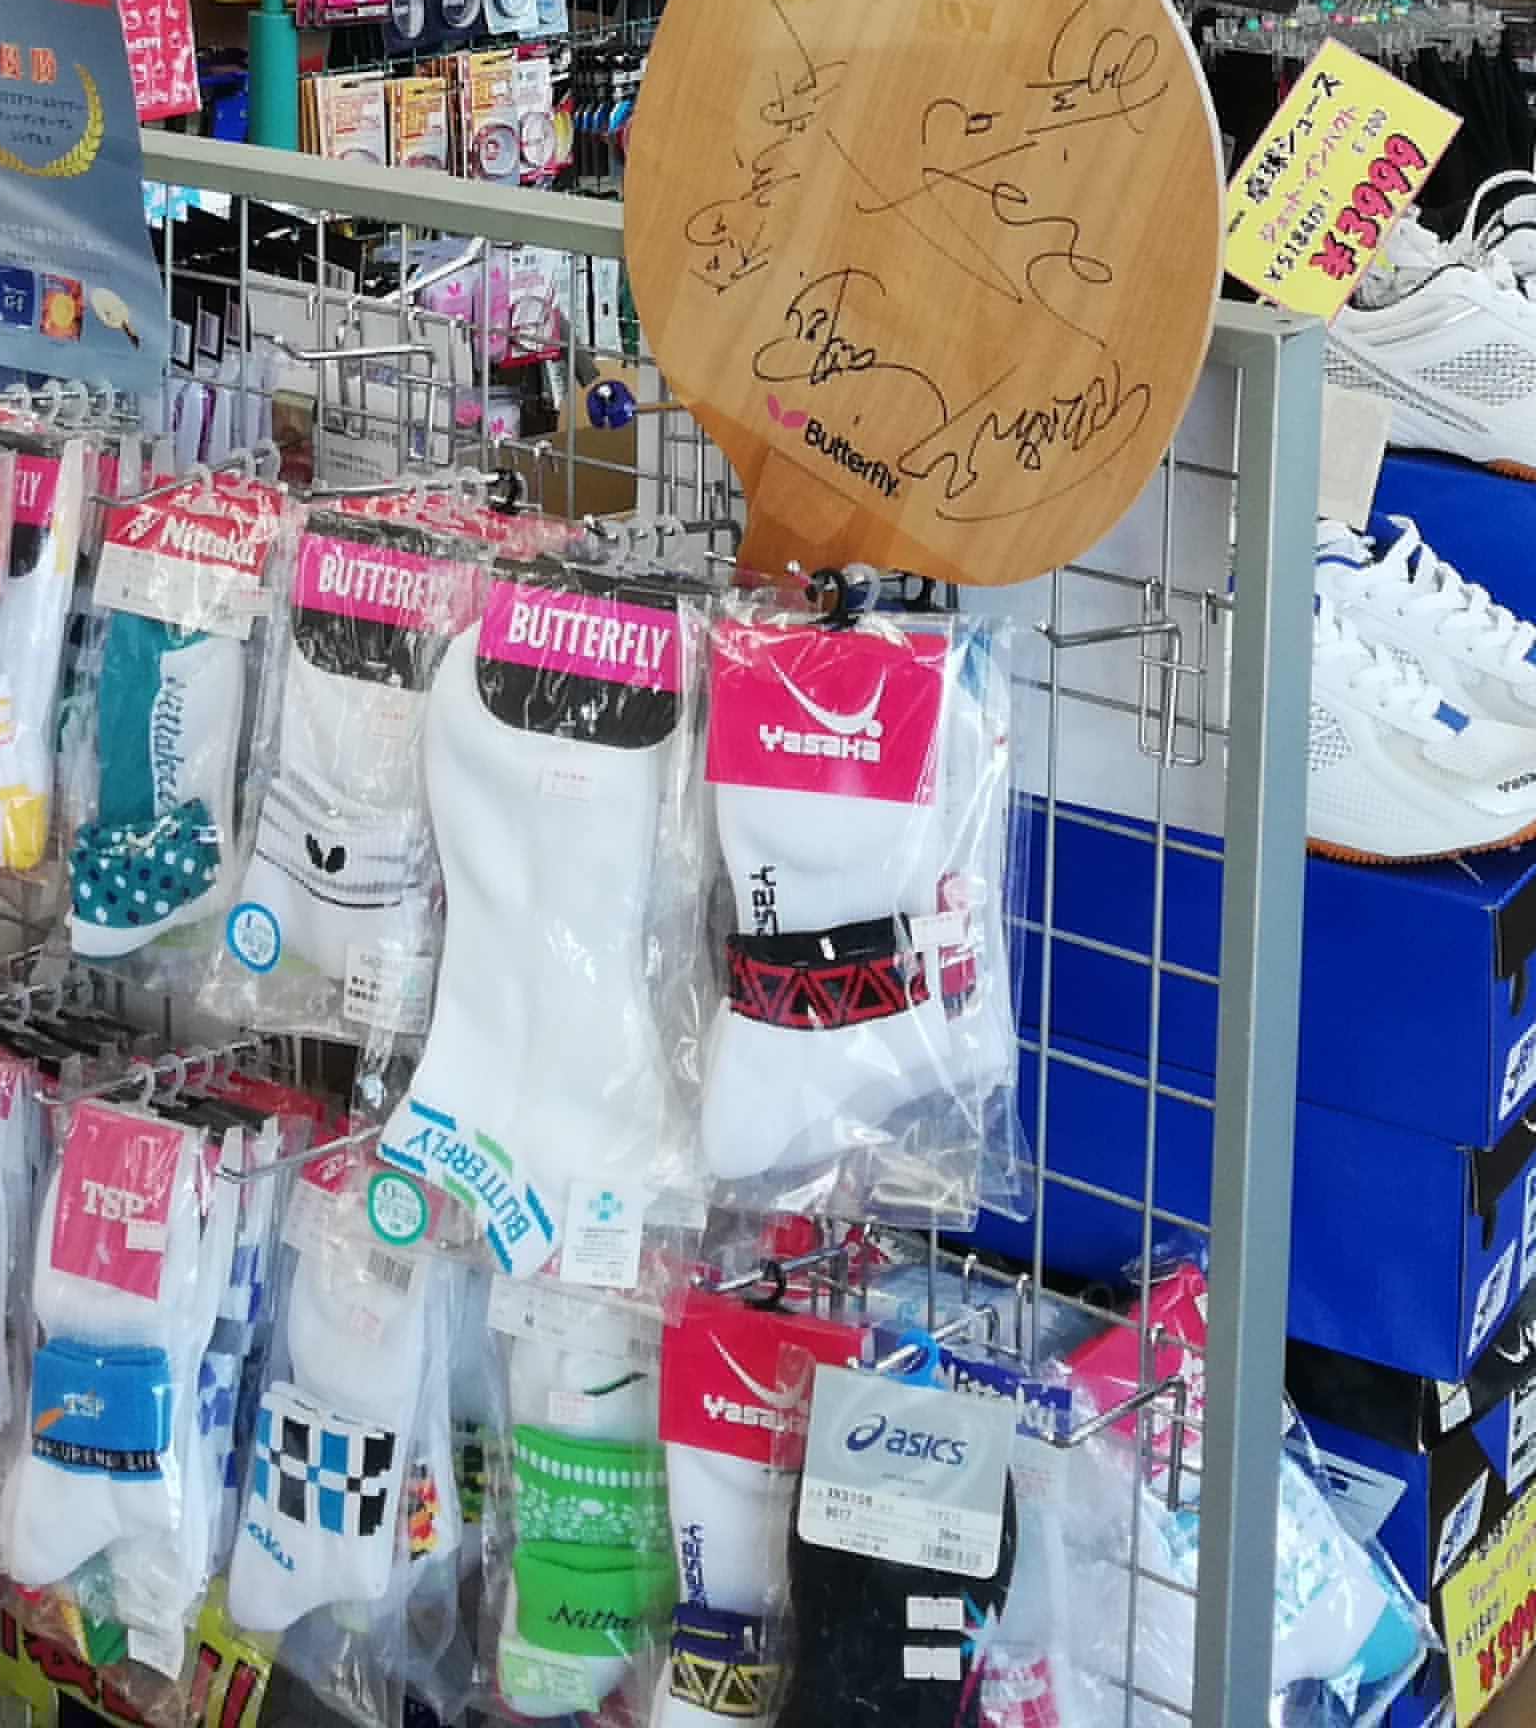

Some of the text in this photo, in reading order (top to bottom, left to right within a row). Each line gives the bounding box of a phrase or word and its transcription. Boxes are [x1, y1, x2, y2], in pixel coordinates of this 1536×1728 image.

[1308, 133, 1427, 281] ¥3999
[804, 416, 901, 499] Butterfly
[158, 517, 257, 566] Nittaku
[317, 558, 454, 614] BUTTERFLY
[508, 602, 670, 670] BUTTERFLY
[758, 724, 882, 763] Yasaka
[81, 1182, 146, 1222] TSP
[405, 1128, 533, 1246] BUTTERFLY
[884, 1426, 968, 1466] asics
